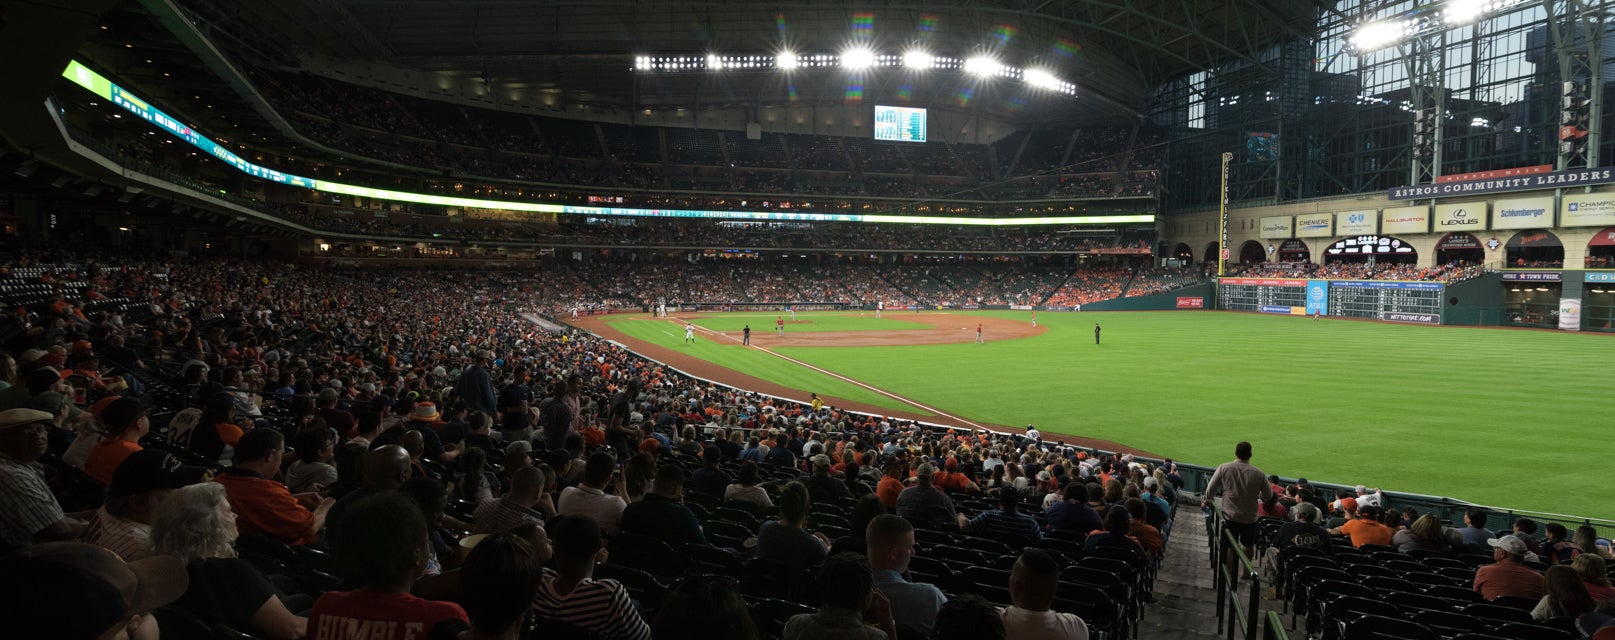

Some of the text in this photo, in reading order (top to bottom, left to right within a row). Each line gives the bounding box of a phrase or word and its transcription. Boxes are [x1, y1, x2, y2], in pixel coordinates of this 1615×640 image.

[1395, 170, 1611, 198] ASTROS COMMUNITY LEADERS
[1500, 208, 1545, 218] Schlumberger
[1299, 218, 1329, 226] CHENIERE
[1440, 218, 1478, 226] LEXUS
[315, 613, 425, 640] HUMBLE
